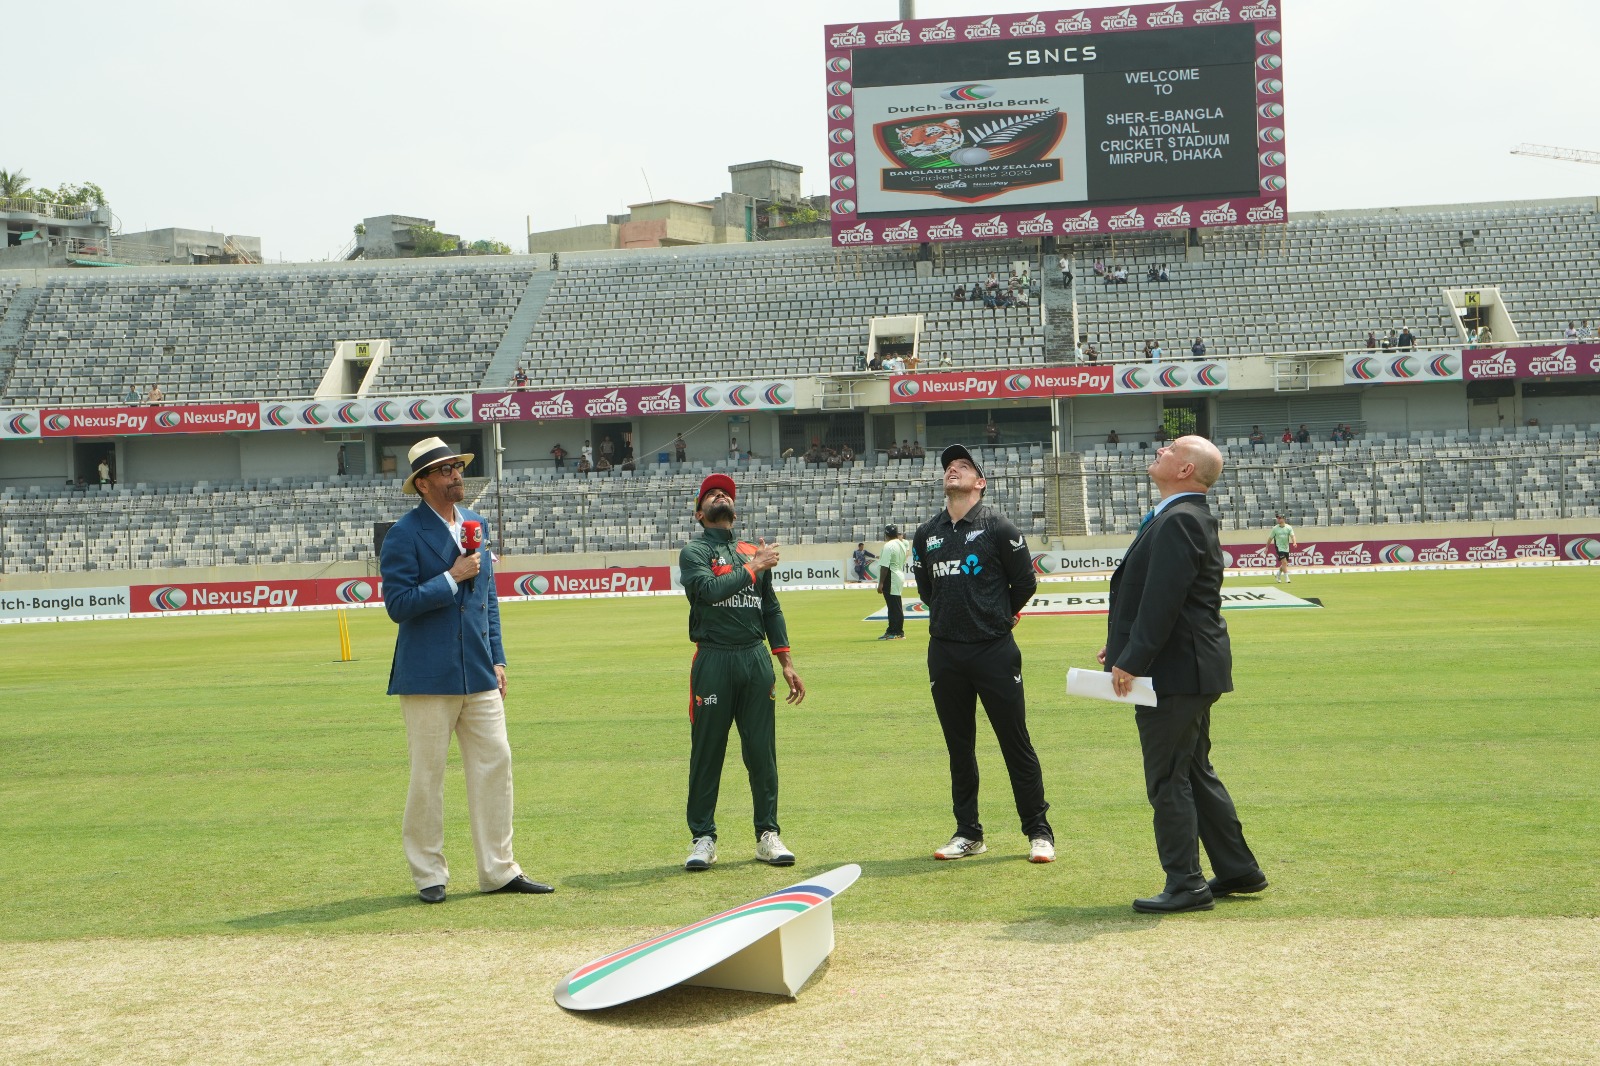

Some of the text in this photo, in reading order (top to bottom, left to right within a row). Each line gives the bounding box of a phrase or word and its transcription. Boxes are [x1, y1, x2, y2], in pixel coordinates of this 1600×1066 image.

[1008, 46, 1097, 66] SBNCS
[1125, 69, 1199, 84] WELCOME
[1154, 84, 1172, 95] TO
[888, 98, 1049, 114] Dutch-Bangla Bank
[1106, 108, 1224, 125] SHER-E-BANGLA
[1129, 123, 1200, 137] NATIONAL
[1100, 134, 1230, 152] CRICKET STADIUM
[1109, 148, 1222, 165] MIRPUR, DHAKA
[890, 168, 962, 176] BANGLADESH
[911, 174, 954, 182] Cricket
[923, 378, 997, 396] NexusPay
[1034, 372, 1110, 391] NexusPay
[74, 413, 147, 431] NexusPay
[184, 409, 256, 427] NexusPay
[808, 567, 840, 578] Bank
[933, 560, 960, 578] ANZ
[554, 573, 653, 592] NexusPay
[0, 594, 125, 610] tch-Bangla Bank
[192, 585, 298, 607] NexusPay
[704, 694, 717, 705] রবি
